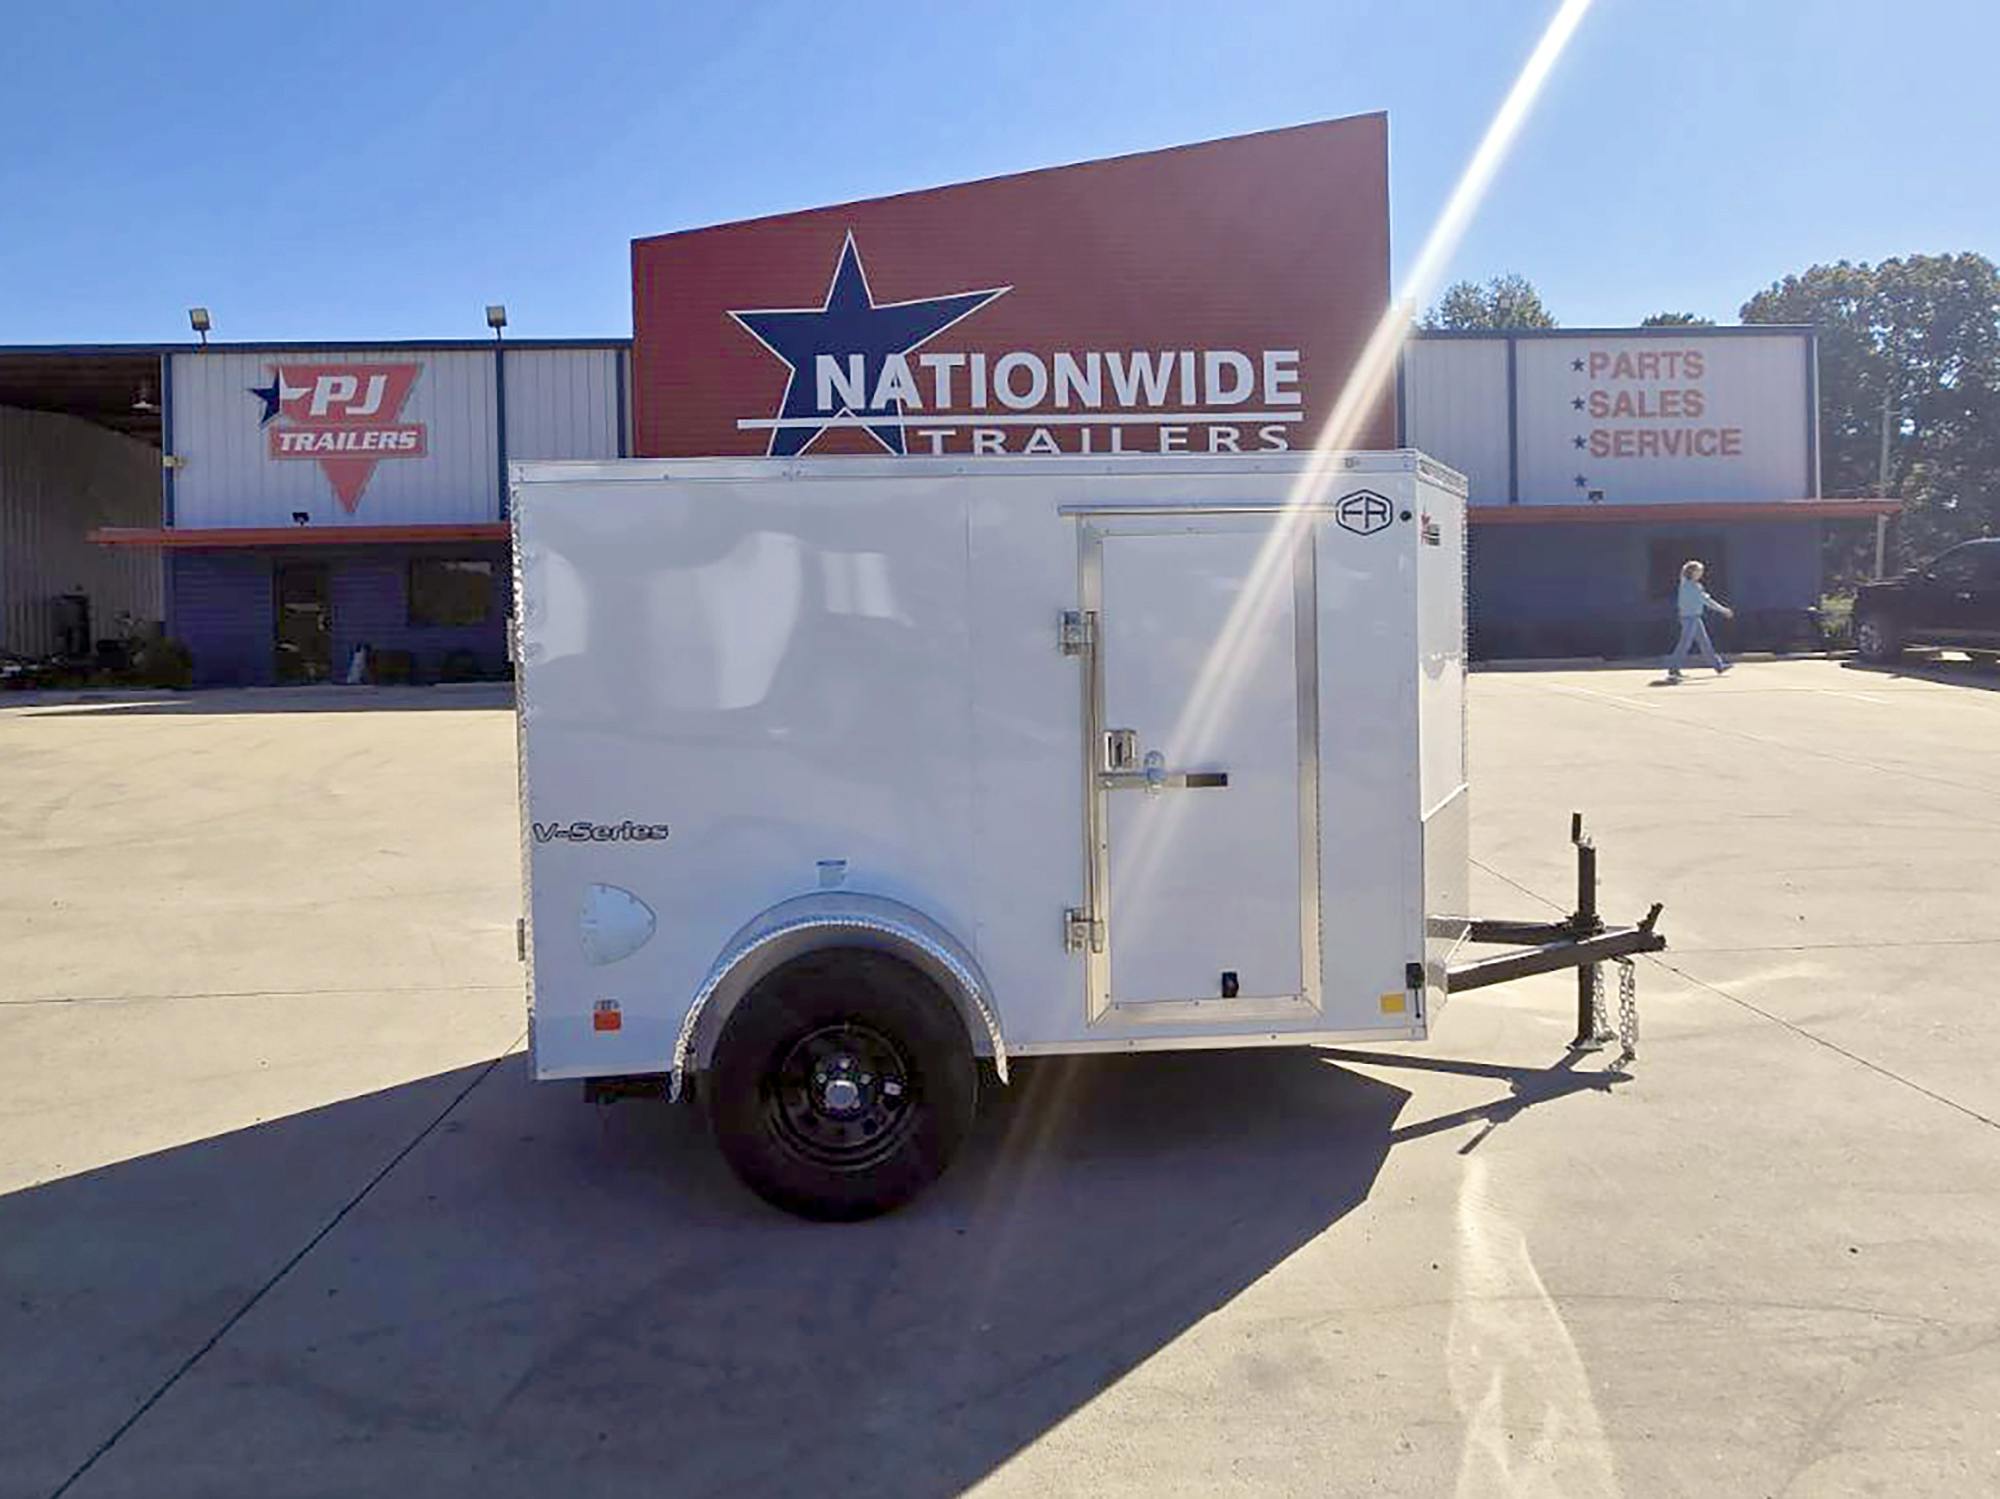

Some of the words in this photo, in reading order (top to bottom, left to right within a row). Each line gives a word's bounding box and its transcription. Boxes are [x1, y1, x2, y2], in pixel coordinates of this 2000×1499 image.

[1589, 351, 1704, 379] PARTS
[310, 374, 387, 415] PJ
[815, 350, 1302, 410] NATIONWIDE
[1589, 389, 1704, 418] SALES
[279, 430, 417, 451] TRAILERS
[918, 426, 1289, 455] TRAILERS
[1589, 428, 1742, 458] SERVICE
[533, 821, 669, 842] V-Series
